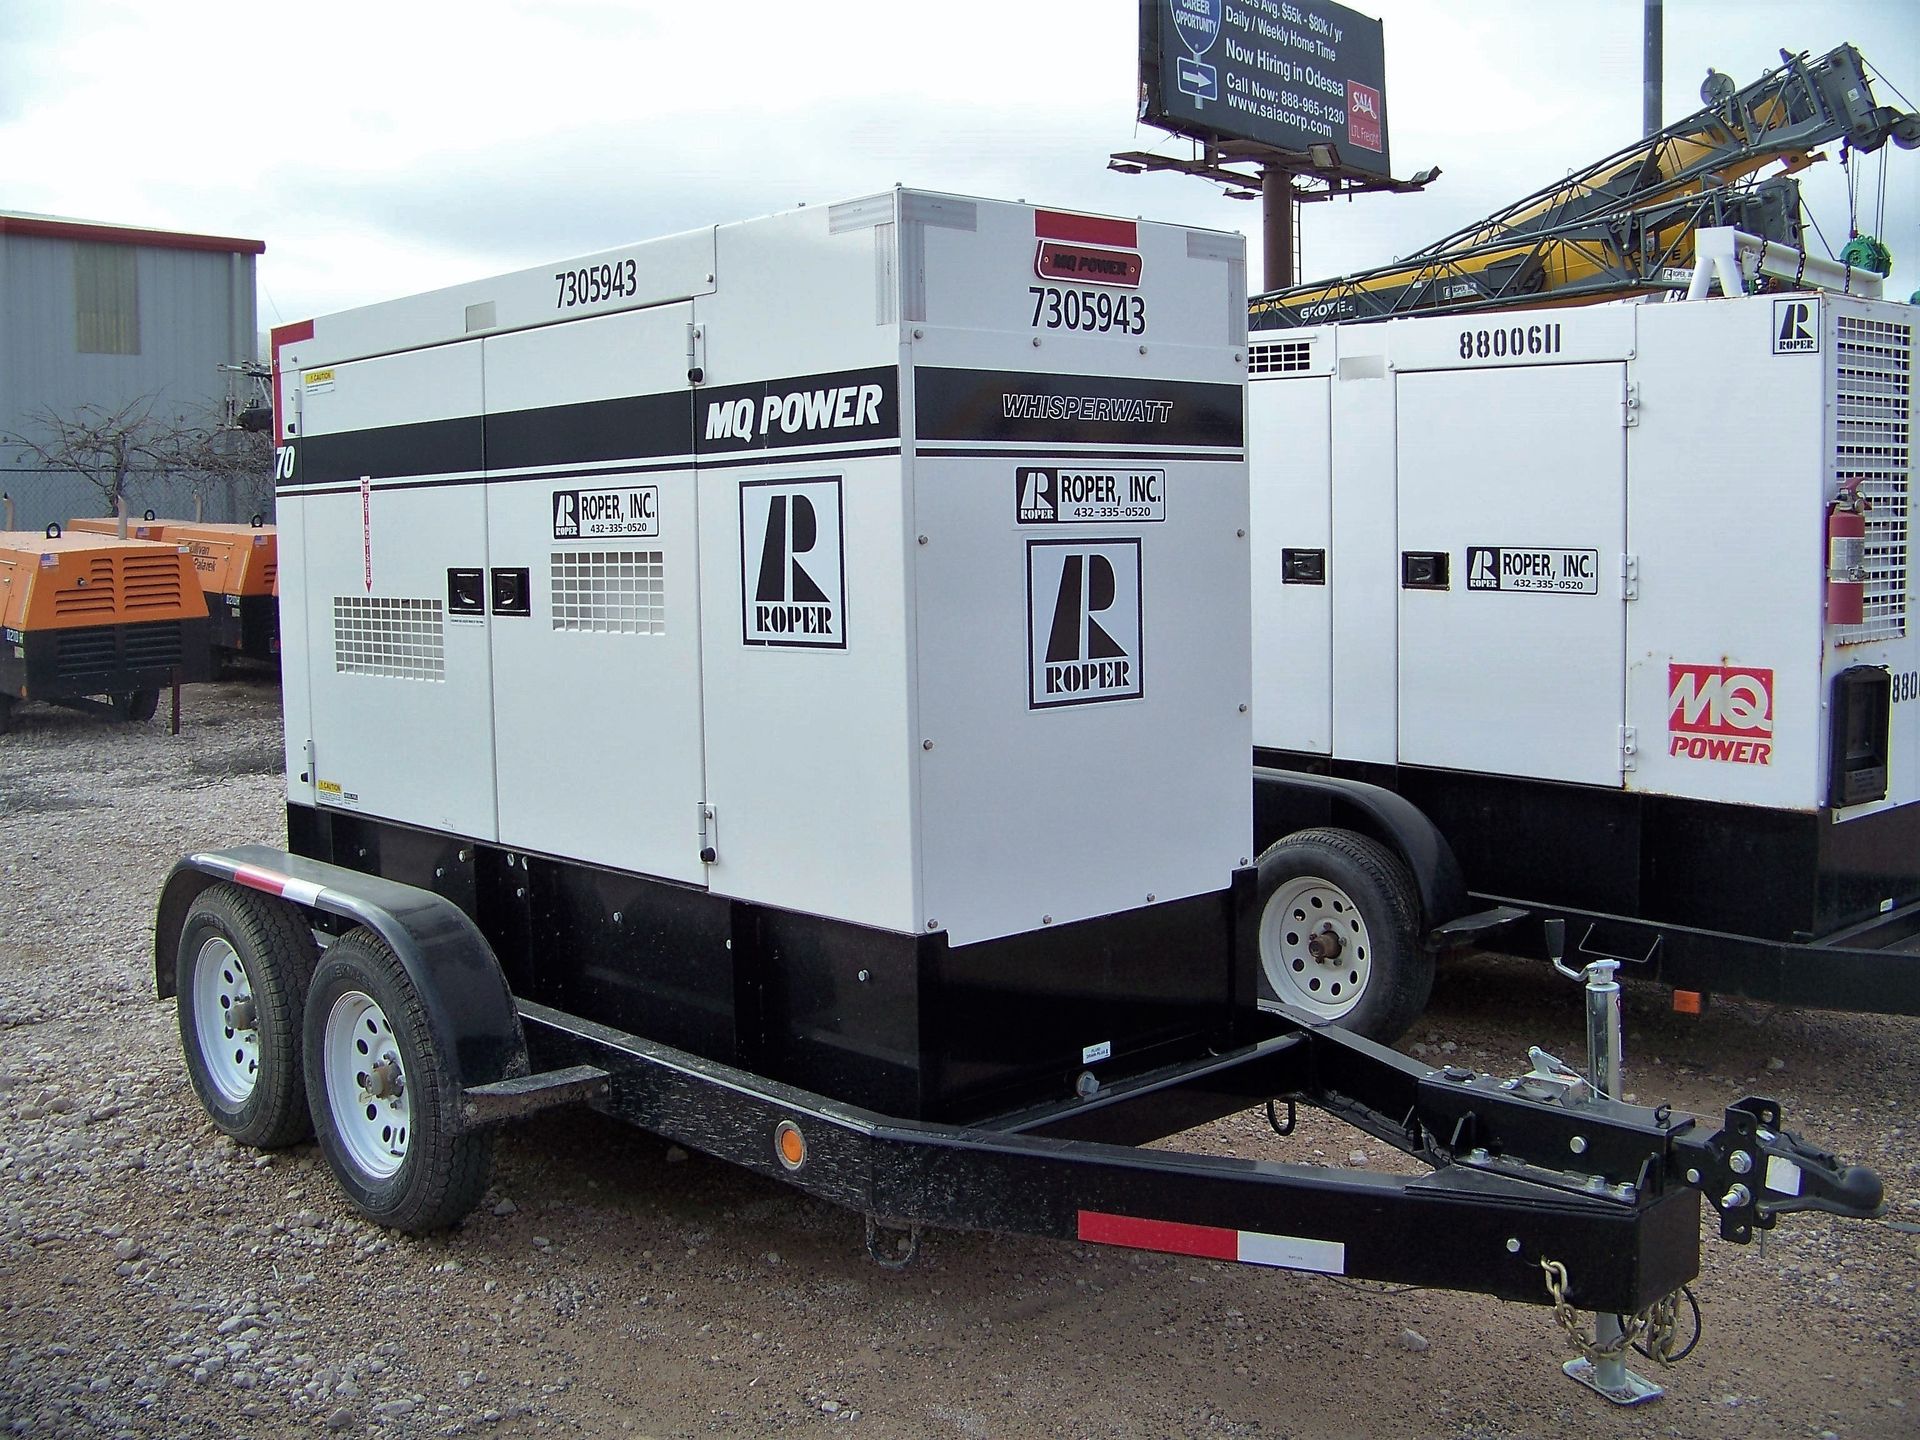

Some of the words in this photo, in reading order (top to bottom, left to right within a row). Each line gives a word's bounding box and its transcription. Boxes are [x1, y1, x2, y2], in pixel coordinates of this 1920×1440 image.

[1175, 10, 1217, 34] OPPORTUNITY
[1225, 5, 1250, 32] Daily
[1257, 17, 1288, 46] Weekly
[1290, 30, 1315, 53] Home
[1316, 40, 1336, 62] Time
[1281, 2, 1302, 24] $55k
[1308, 12, 1328, 35] $80k
[1334, 27, 1343, 43] yr
[1226, 38, 1254, 65] Now
[1257, 49, 1290, 82] Hiring
[1293, 61, 1303, 82] in
[1305, 66, 1344, 97] Odessa
[1226, 72, 1248, 94] Call
[1252, 80, 1279, 103] Now:
[1281, 90, 1345, 125] 888-965-1230
[1352, 91, 1377, 119] SAIA
[1227, 93, 1332, 138] www.saiacorp.com
[555, 259, 637, 308] 7305943
[1028, 286, 1146, 336] 7305943
[1459, 323, 1561, 360] 8800611
[1779, 340, 1814, 350] ROPER
[705, 398, 755, 443] MQ
[759, 384, 883, 435] POWER
[1002, 393, 1173, 423] WHISPERWATT
[276, 446, 295, 480] 70
[1061, 475, 1122, 507] ROPER,
[1129, 475, 1161, 502] INC.
[581, 494, 624, 522] ROPER,
[630, 492, 655, 519] INC.
[1020, 508, 1054, 520] ROPER
[1074, 507, 1151, 517] 432-335-0520
[556, 527, 578, 535] ROPER
[590, 523, 647, 533] 432-335-0520
[1503, 553, 1556, 579] ROPER,
[1563, 554, 1594, 578] INC.
[1470, 580, 1497, 588] ROPER
[1513, 579, 1583, 590] 432-335-0520
[756, 605, 833, 634] ROPER
[1045, 660, 1130, 694] ROPER
[1892, 670, 1920, 703] 880
[1669, 672, 1773, 730] MQ
[1669, 735, 1772, 766] POWER
